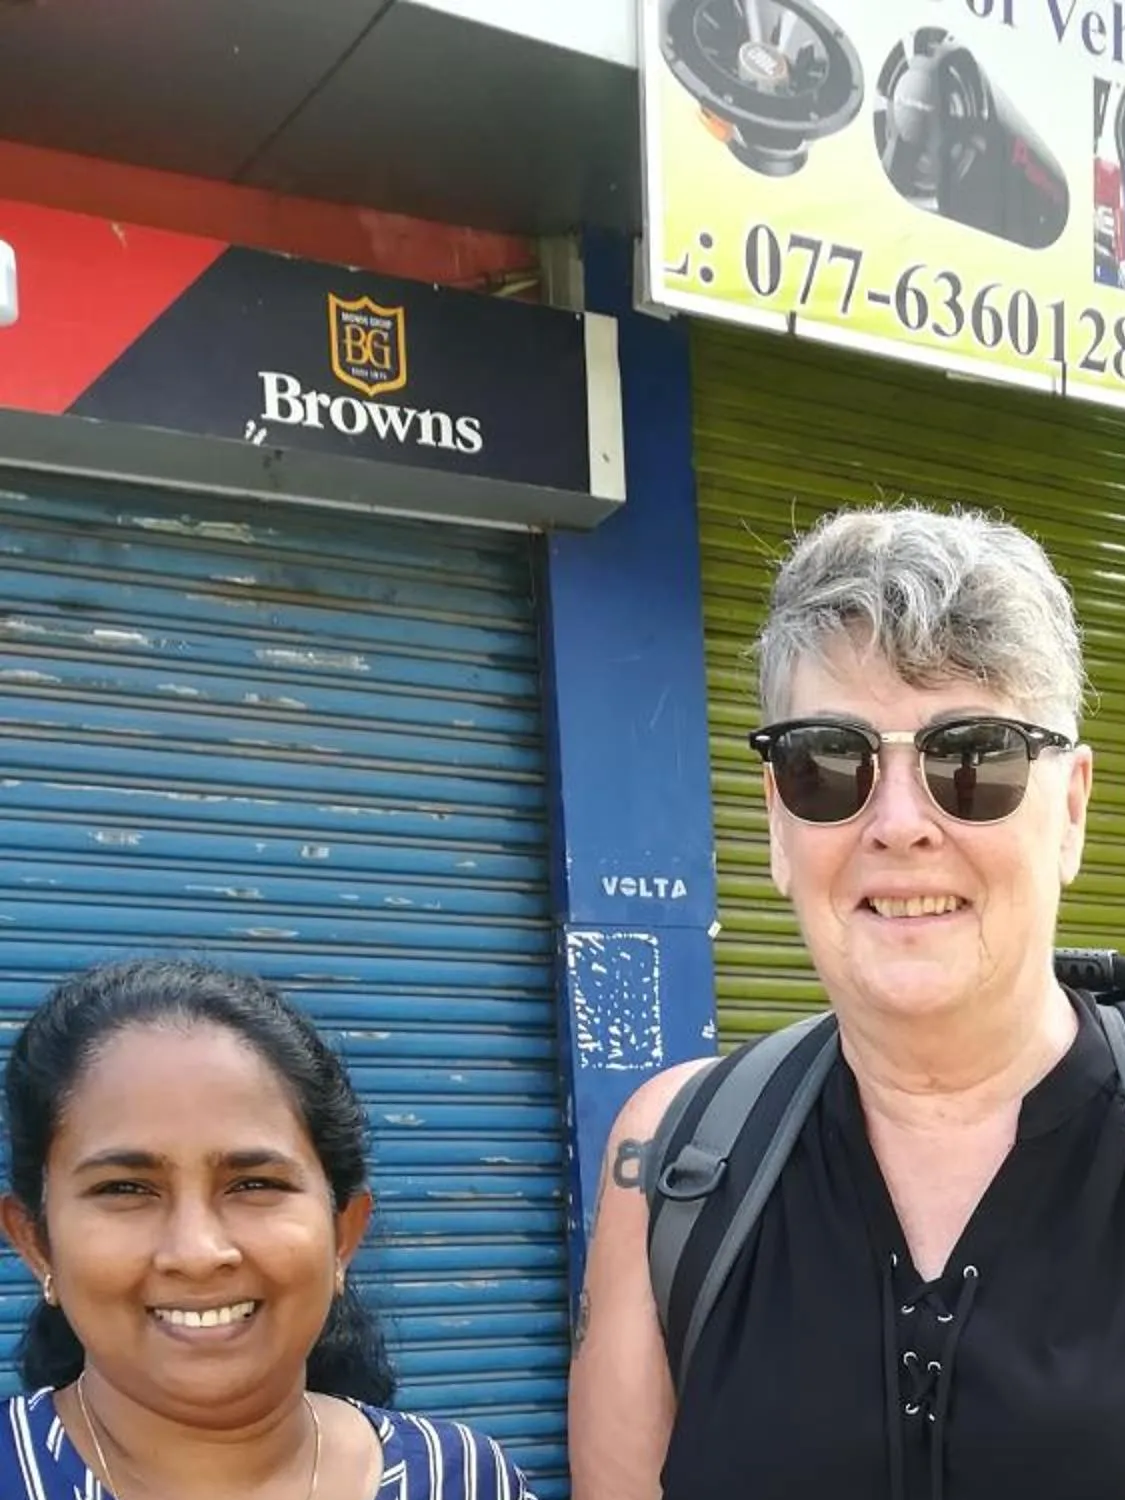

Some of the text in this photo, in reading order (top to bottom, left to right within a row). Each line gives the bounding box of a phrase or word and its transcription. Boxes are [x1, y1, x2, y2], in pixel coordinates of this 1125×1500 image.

[345, 323, 391, 370] BG
[258, 371, 484, 454] Browns
[602, 876, 688, 899] VOLTA
